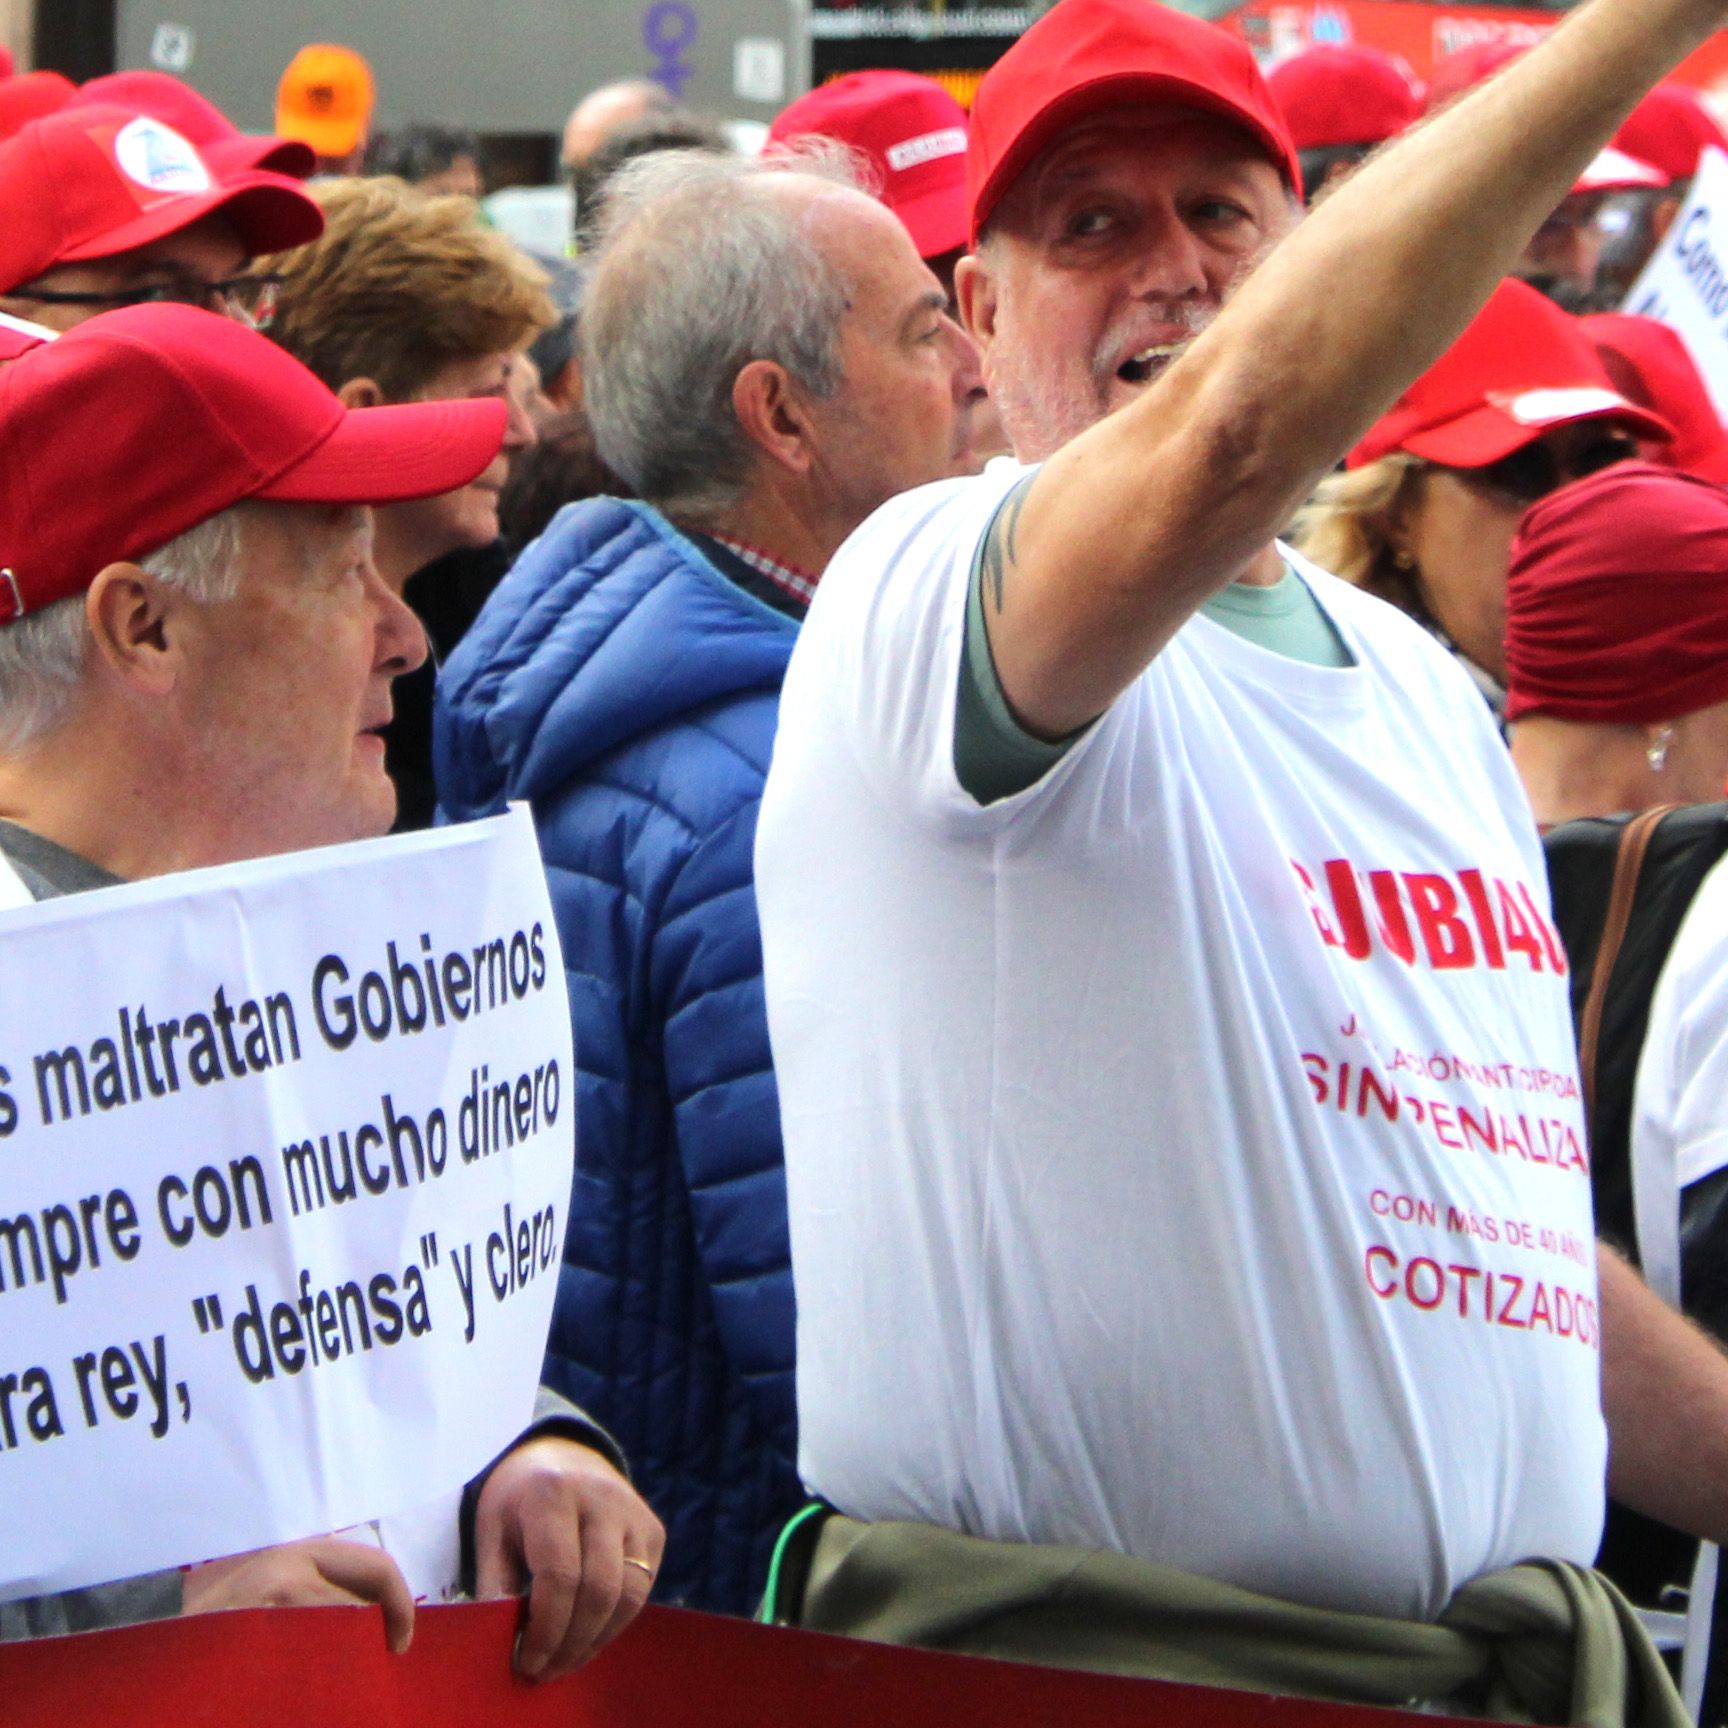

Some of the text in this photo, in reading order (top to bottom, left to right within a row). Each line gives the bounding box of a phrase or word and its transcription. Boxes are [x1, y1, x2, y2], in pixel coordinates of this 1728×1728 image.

[33, 983, 304, 1127] maltratan
[310, 918, 549, 1053] Gobiernos
[1300, 1052, 1399, 1123] SIN
[156, 1151, 273, 1252] con
[279, 1094, 449, 1219] mucho
[455, 1056, 562, 1168] dinero
[1369, 1188, 1437, 1228] CON
[1504, 1219, 1535, 1250] DE
[74, 1332, 195, 1442] rey,
[192, 1232, 441, 1387] "defensa"
[450, 1248, 478, 1346] y
[483, 1200, 559, 1308] clero.
